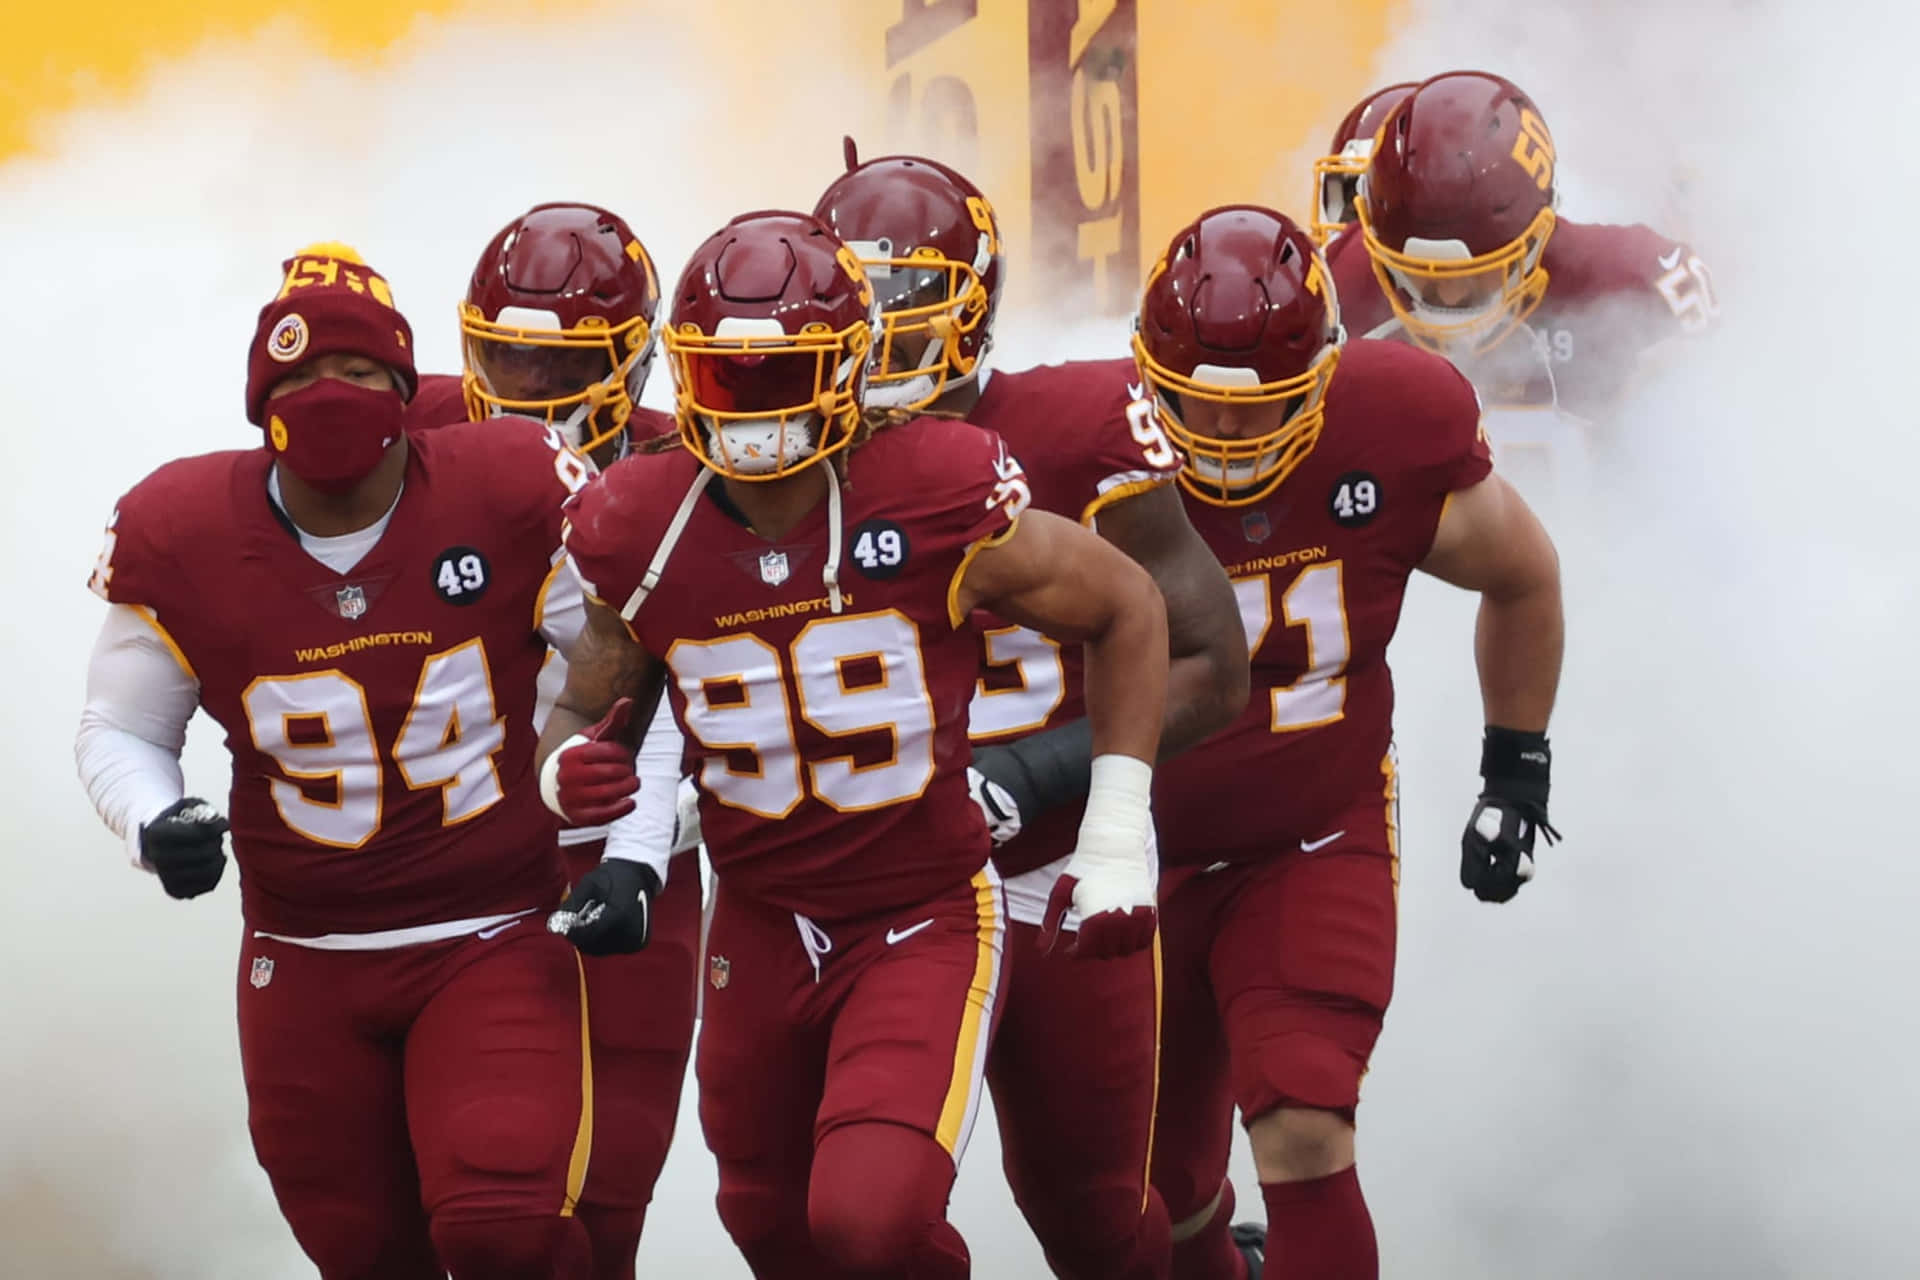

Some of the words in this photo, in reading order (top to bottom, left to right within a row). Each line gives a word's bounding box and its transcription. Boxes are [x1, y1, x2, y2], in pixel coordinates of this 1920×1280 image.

[1512, 108, 1556, 190] 50
[1333, 480, 1377, 517] 49
[853, 529, 903, 568] 49
[1223, 545, 1328, 577] SHINGTON
[437, 553, 486, 597] 49
[295, 630, 434, 663] WASHINGTON
[665, 608, 936, 820] 99
[241, 636, 508, 850] 94
